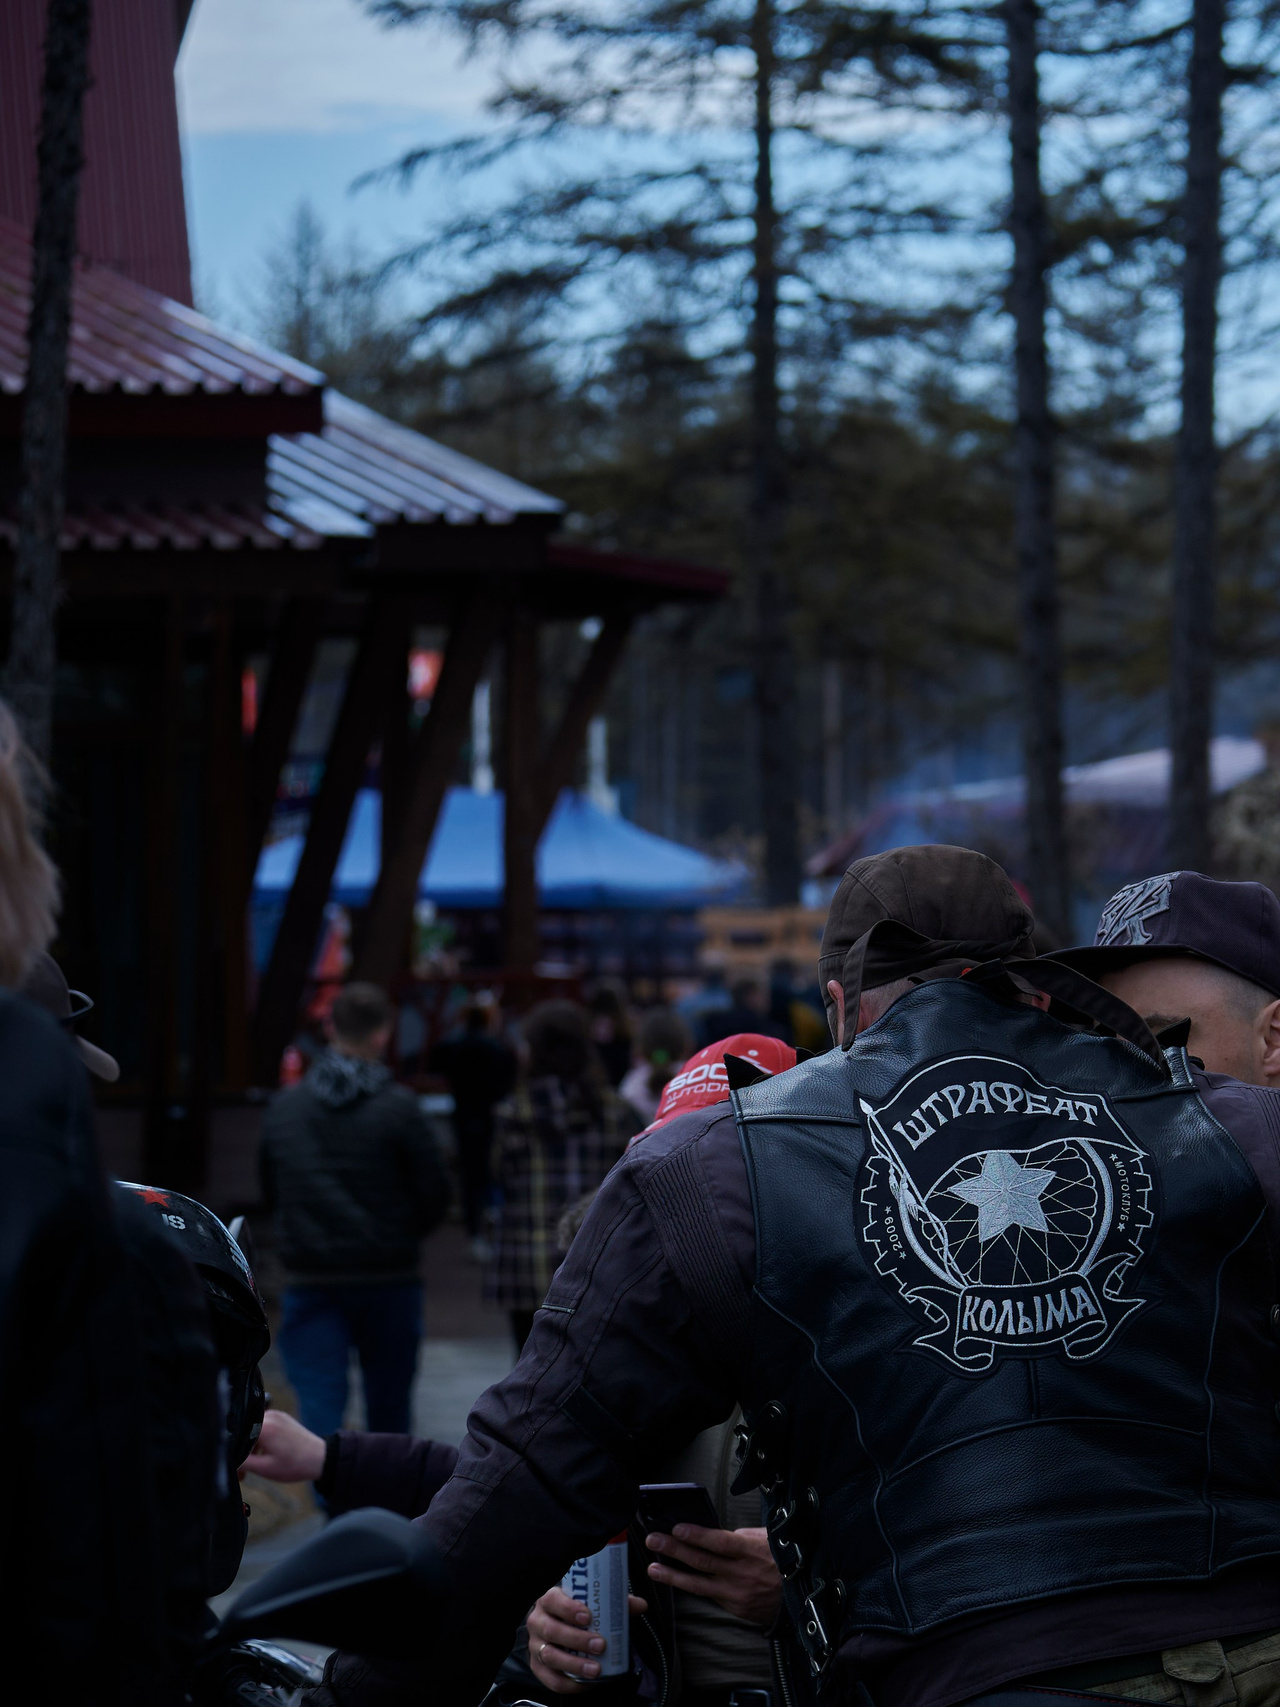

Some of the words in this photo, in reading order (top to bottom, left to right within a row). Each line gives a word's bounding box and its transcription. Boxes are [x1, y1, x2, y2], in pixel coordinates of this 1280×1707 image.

[665, 1063, 729, 1096] SOC
[892, 1081, 1100, 1151] ШТРАФБАТ
[1113, 1160, 1131, 1222] МОТОКЛУБ
[884, 1216, 903, 1251] 2009
[962, 1287, 1098, 1336] КОЛЫМА
